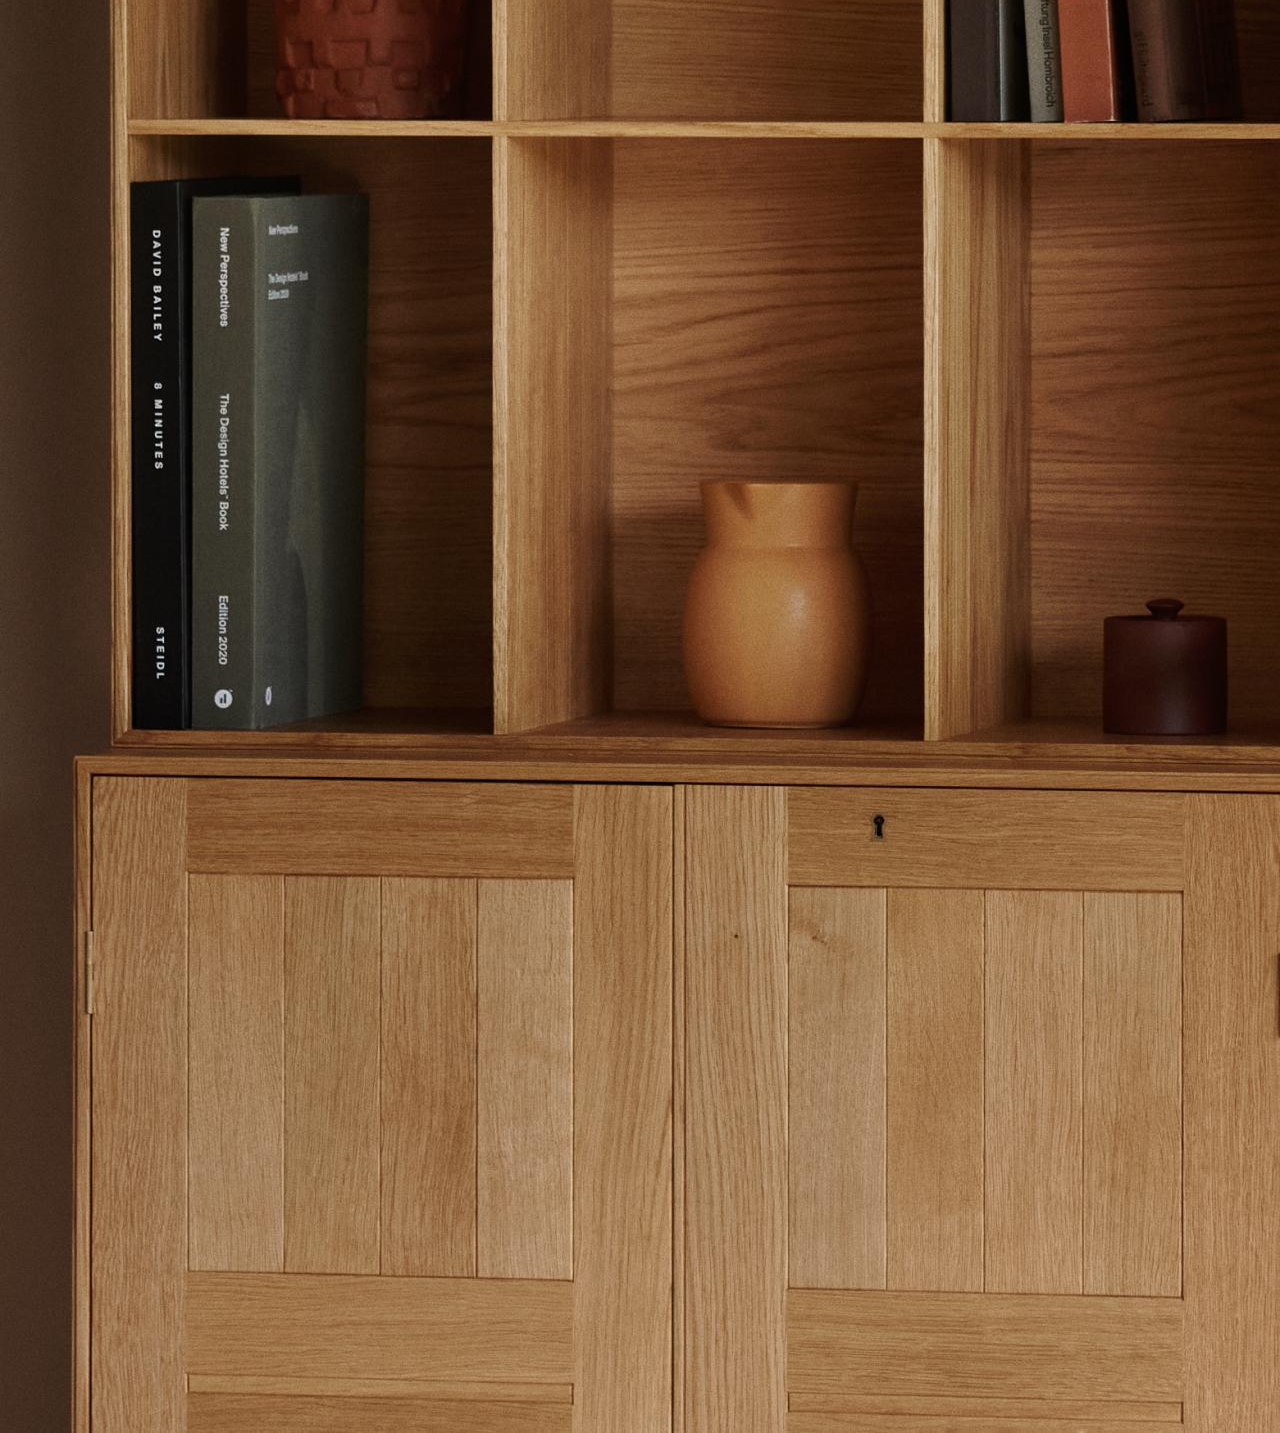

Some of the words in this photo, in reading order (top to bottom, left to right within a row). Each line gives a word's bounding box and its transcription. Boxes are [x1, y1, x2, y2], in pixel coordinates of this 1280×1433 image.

[1042, 27, 1053, 50] Insel
[1043, 51, 1056, 107] Hombroich
[153, 230, 162, 277] DAVID
[219, 227, 230, 251] New
[218, 254, 230, 327] Perspectives
[153, 285, 163, 342] BAILEY
[219, 393, 230, 415] The
[154, 399, 164, 470] MINUTES
[218, 417, 230, 457] Design
[219, 502, 230, 531] Book
[218, 595, 229, 634] Edition
[156, 626, 165, 680] STEIDL
[218, 636, 228, 665] 2020
